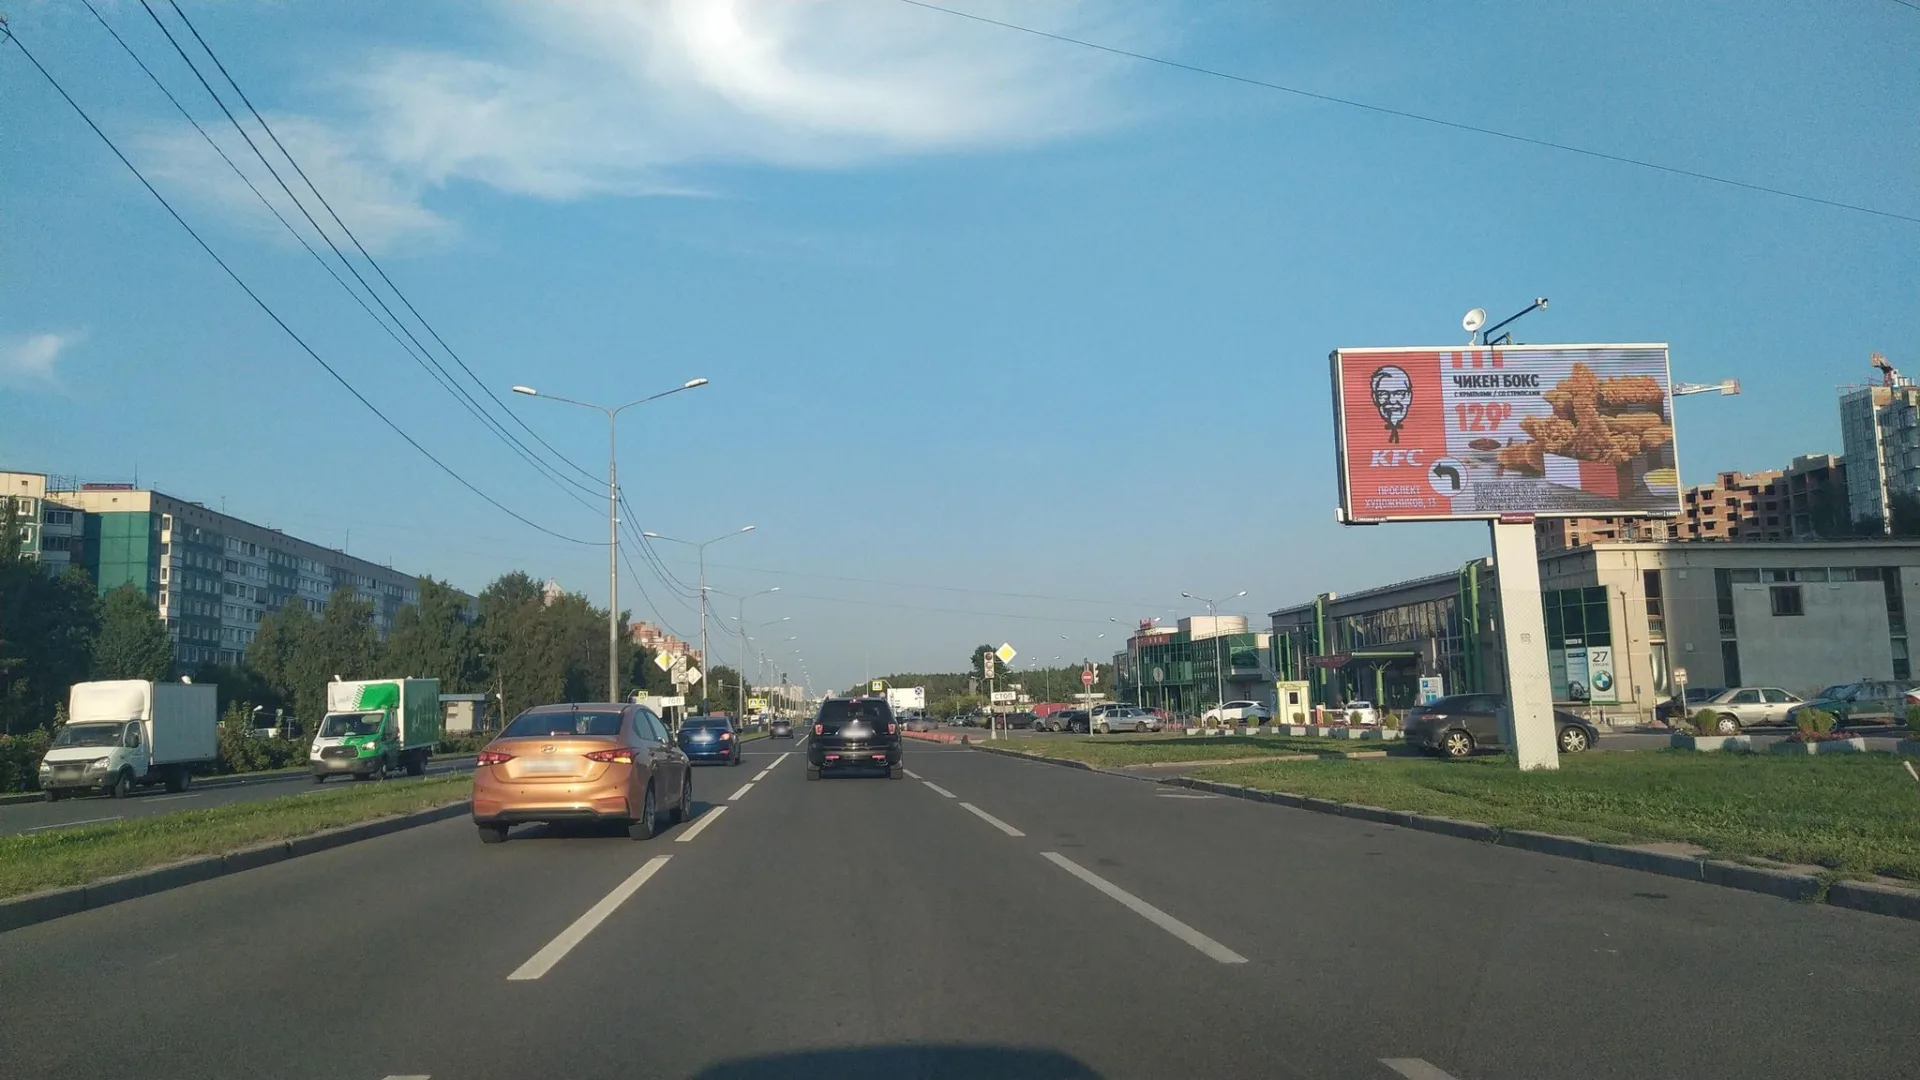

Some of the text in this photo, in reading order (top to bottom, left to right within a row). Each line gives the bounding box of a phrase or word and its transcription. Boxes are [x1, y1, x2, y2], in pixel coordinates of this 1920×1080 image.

[1453, 374, 1539, 388] ЧИКЕН БОКС
[1369, 449, 1424, 467] KFC
[1378, 485, 1421, 496] ПРОСПЕКТ
[1428, 498, 1437, 508] 13
[1592, 651, 1608, 662] 27
[994, 692, 1013, 700] СТОП
